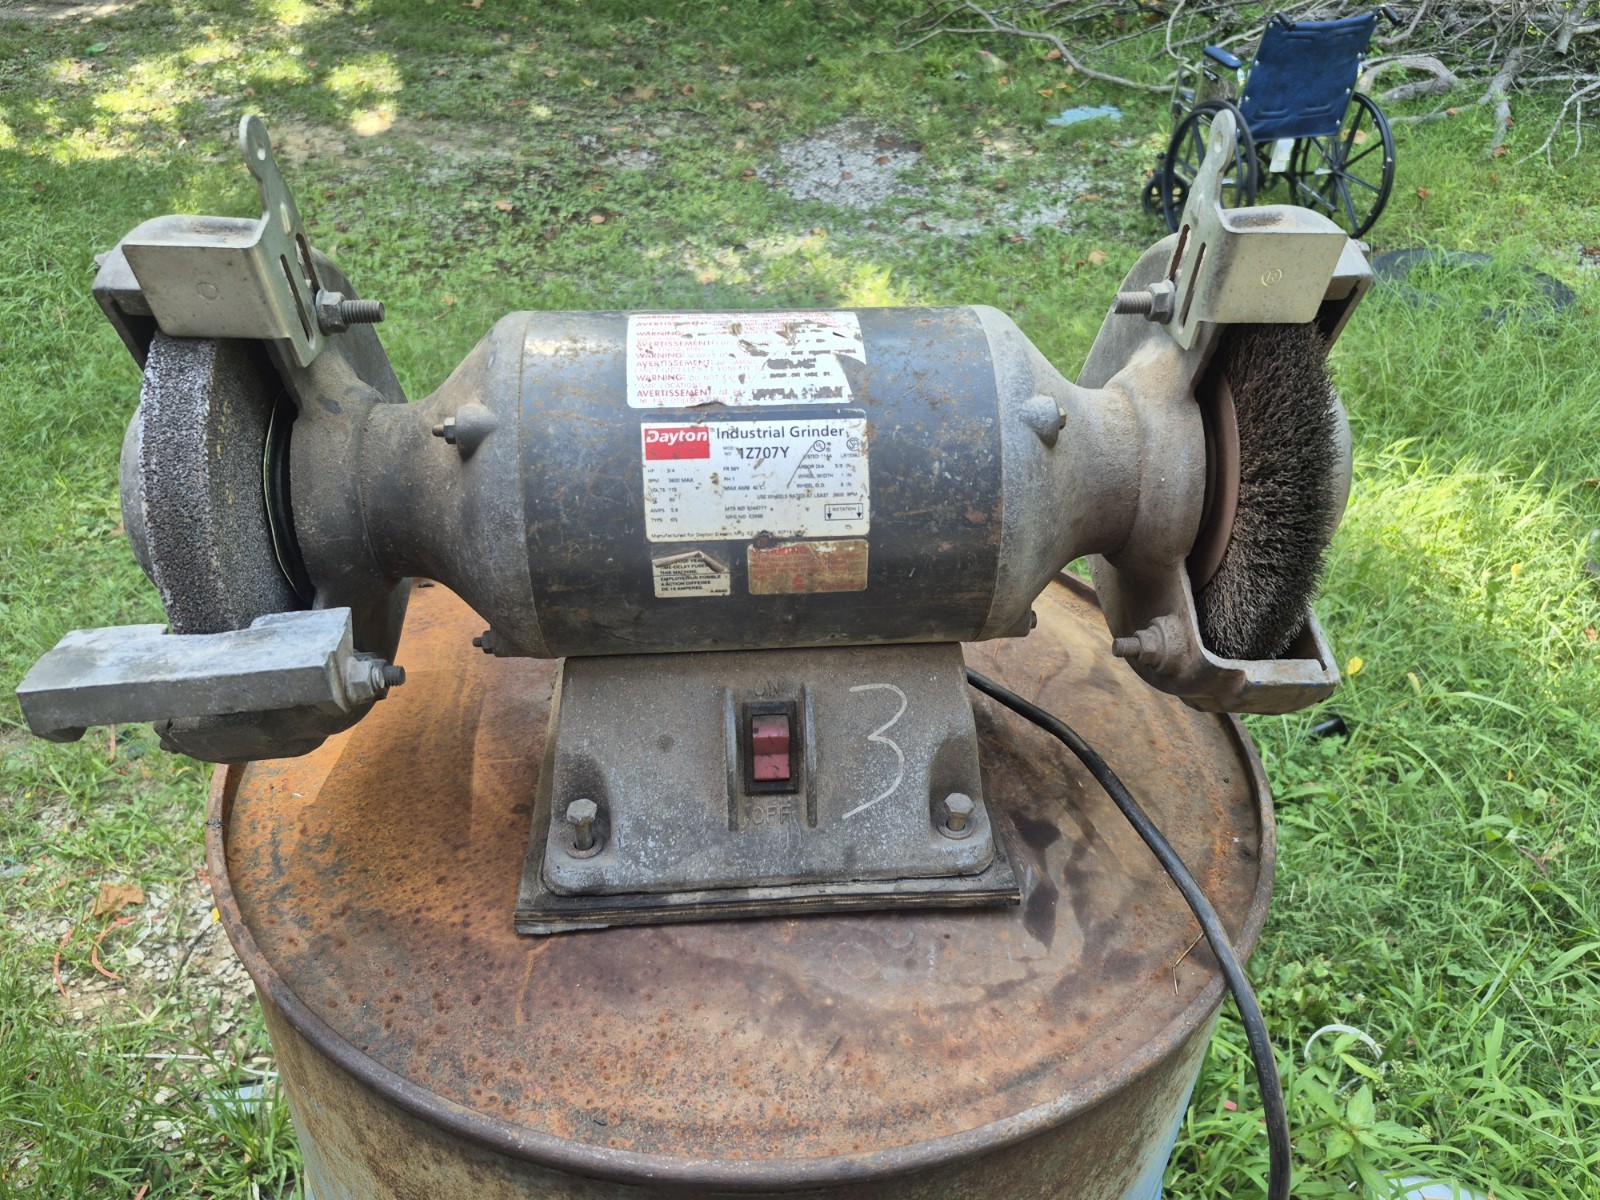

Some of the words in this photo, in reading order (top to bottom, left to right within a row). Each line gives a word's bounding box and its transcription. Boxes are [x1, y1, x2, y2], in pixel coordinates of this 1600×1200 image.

[646, 429, 708, 446] Dayton
[717, 425, 785, 440] Industrial
[789, 424, 845, 438] Grinder
[738, 445, 790, 459] 1Z707Y
[753, 681, 779, 697] ON
[841, 683, 908, 820] 3
[751, 804, 791, 824] OFF
